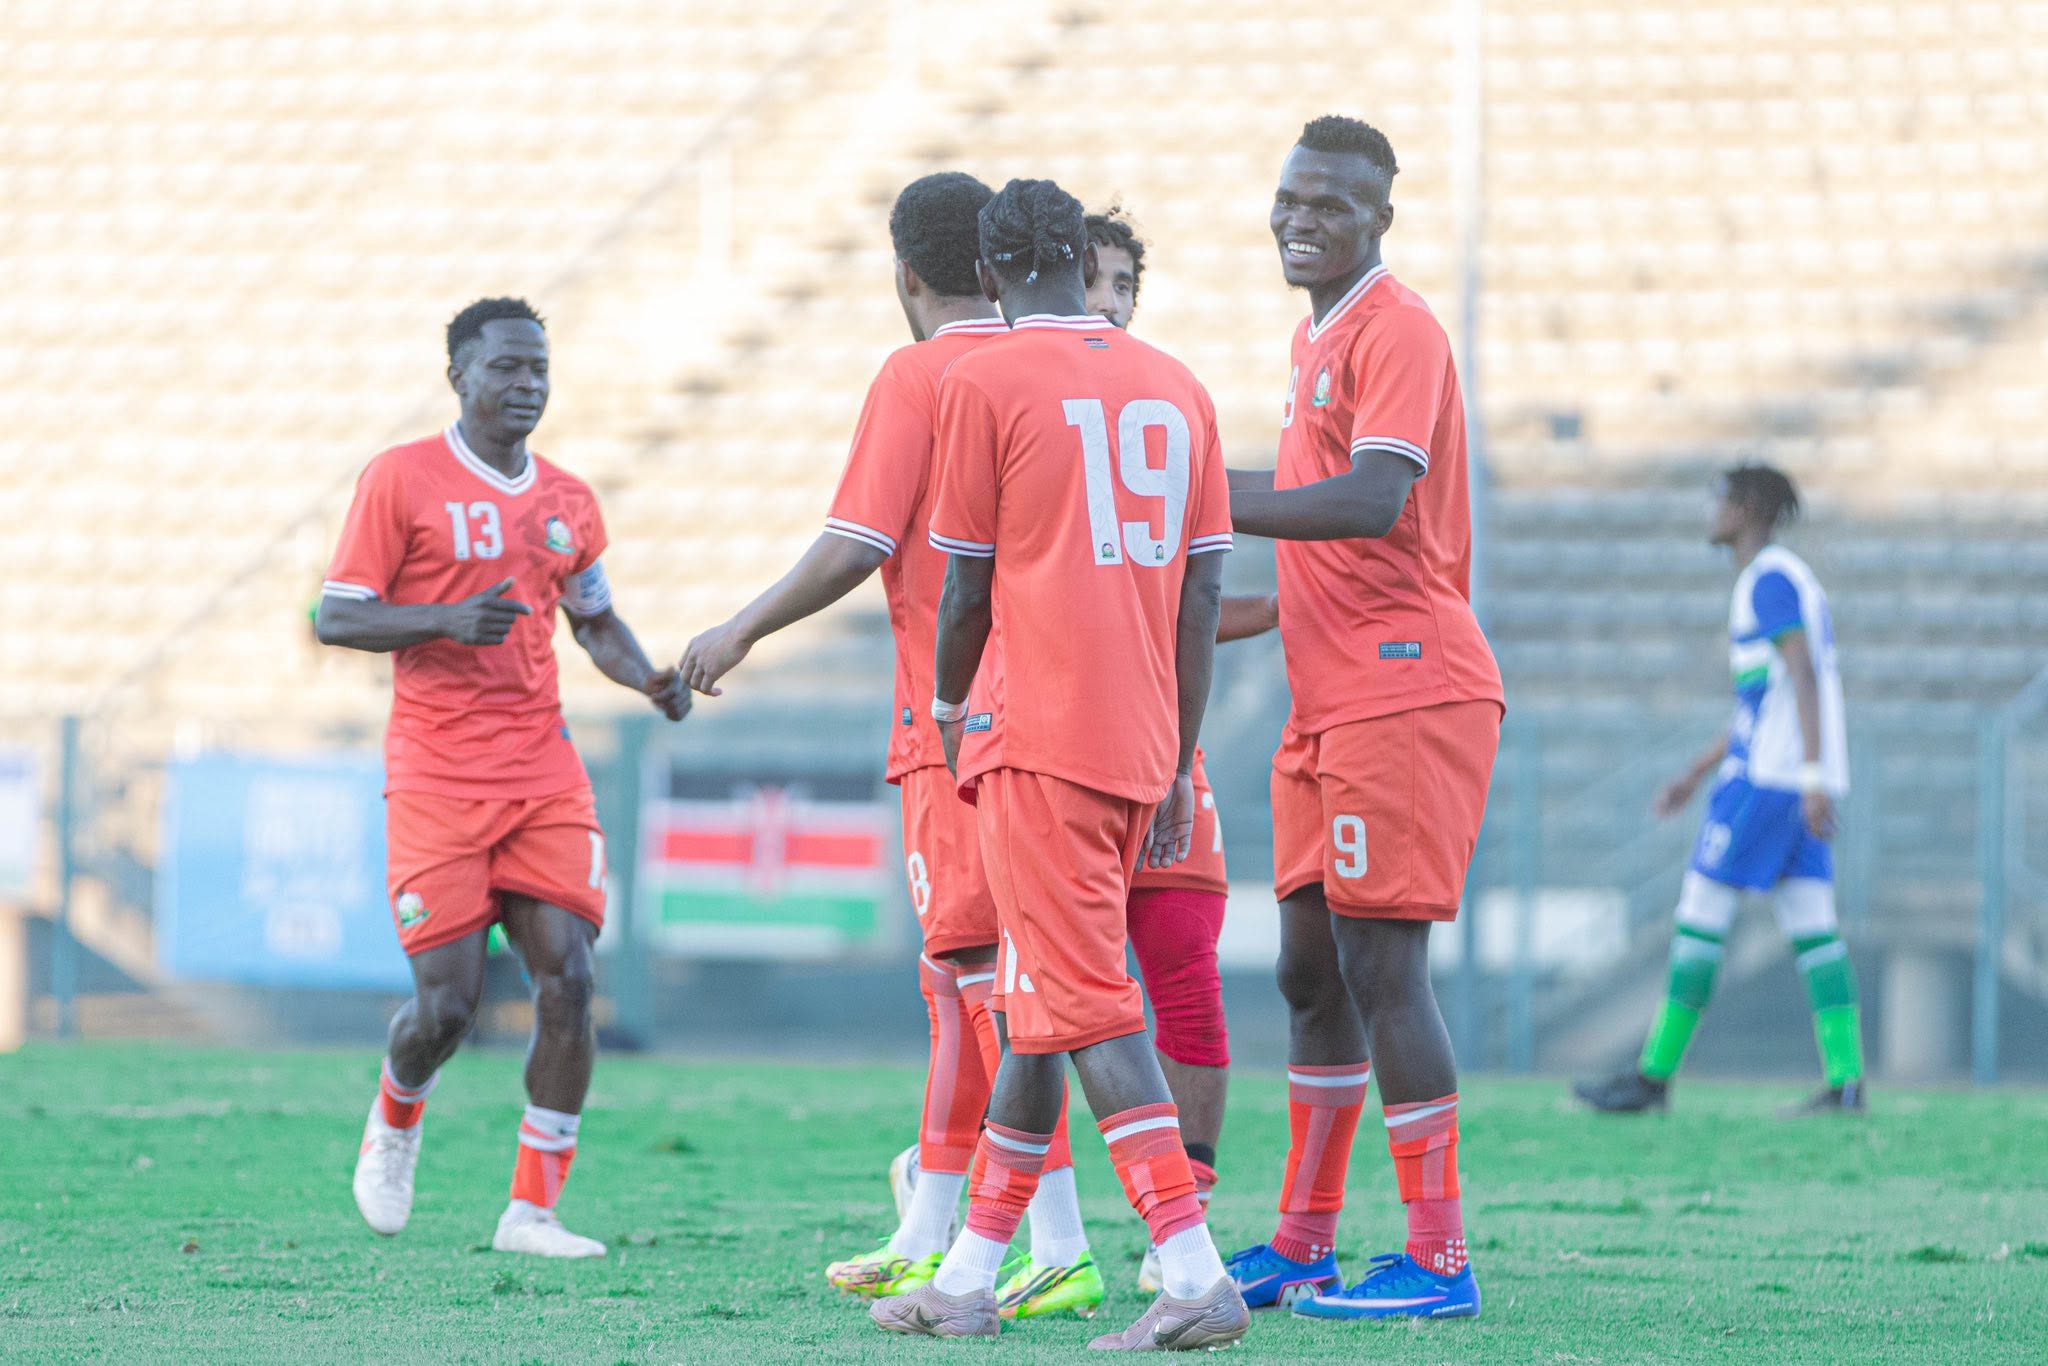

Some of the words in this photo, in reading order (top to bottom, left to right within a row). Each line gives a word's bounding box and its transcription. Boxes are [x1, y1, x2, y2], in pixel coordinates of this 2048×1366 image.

[1061, 398, 1191, 568] 19
[444, 500, 504, 561] 13
[1333, 814, 1367, 879] 9
[908, 850, 931, 916] 8
